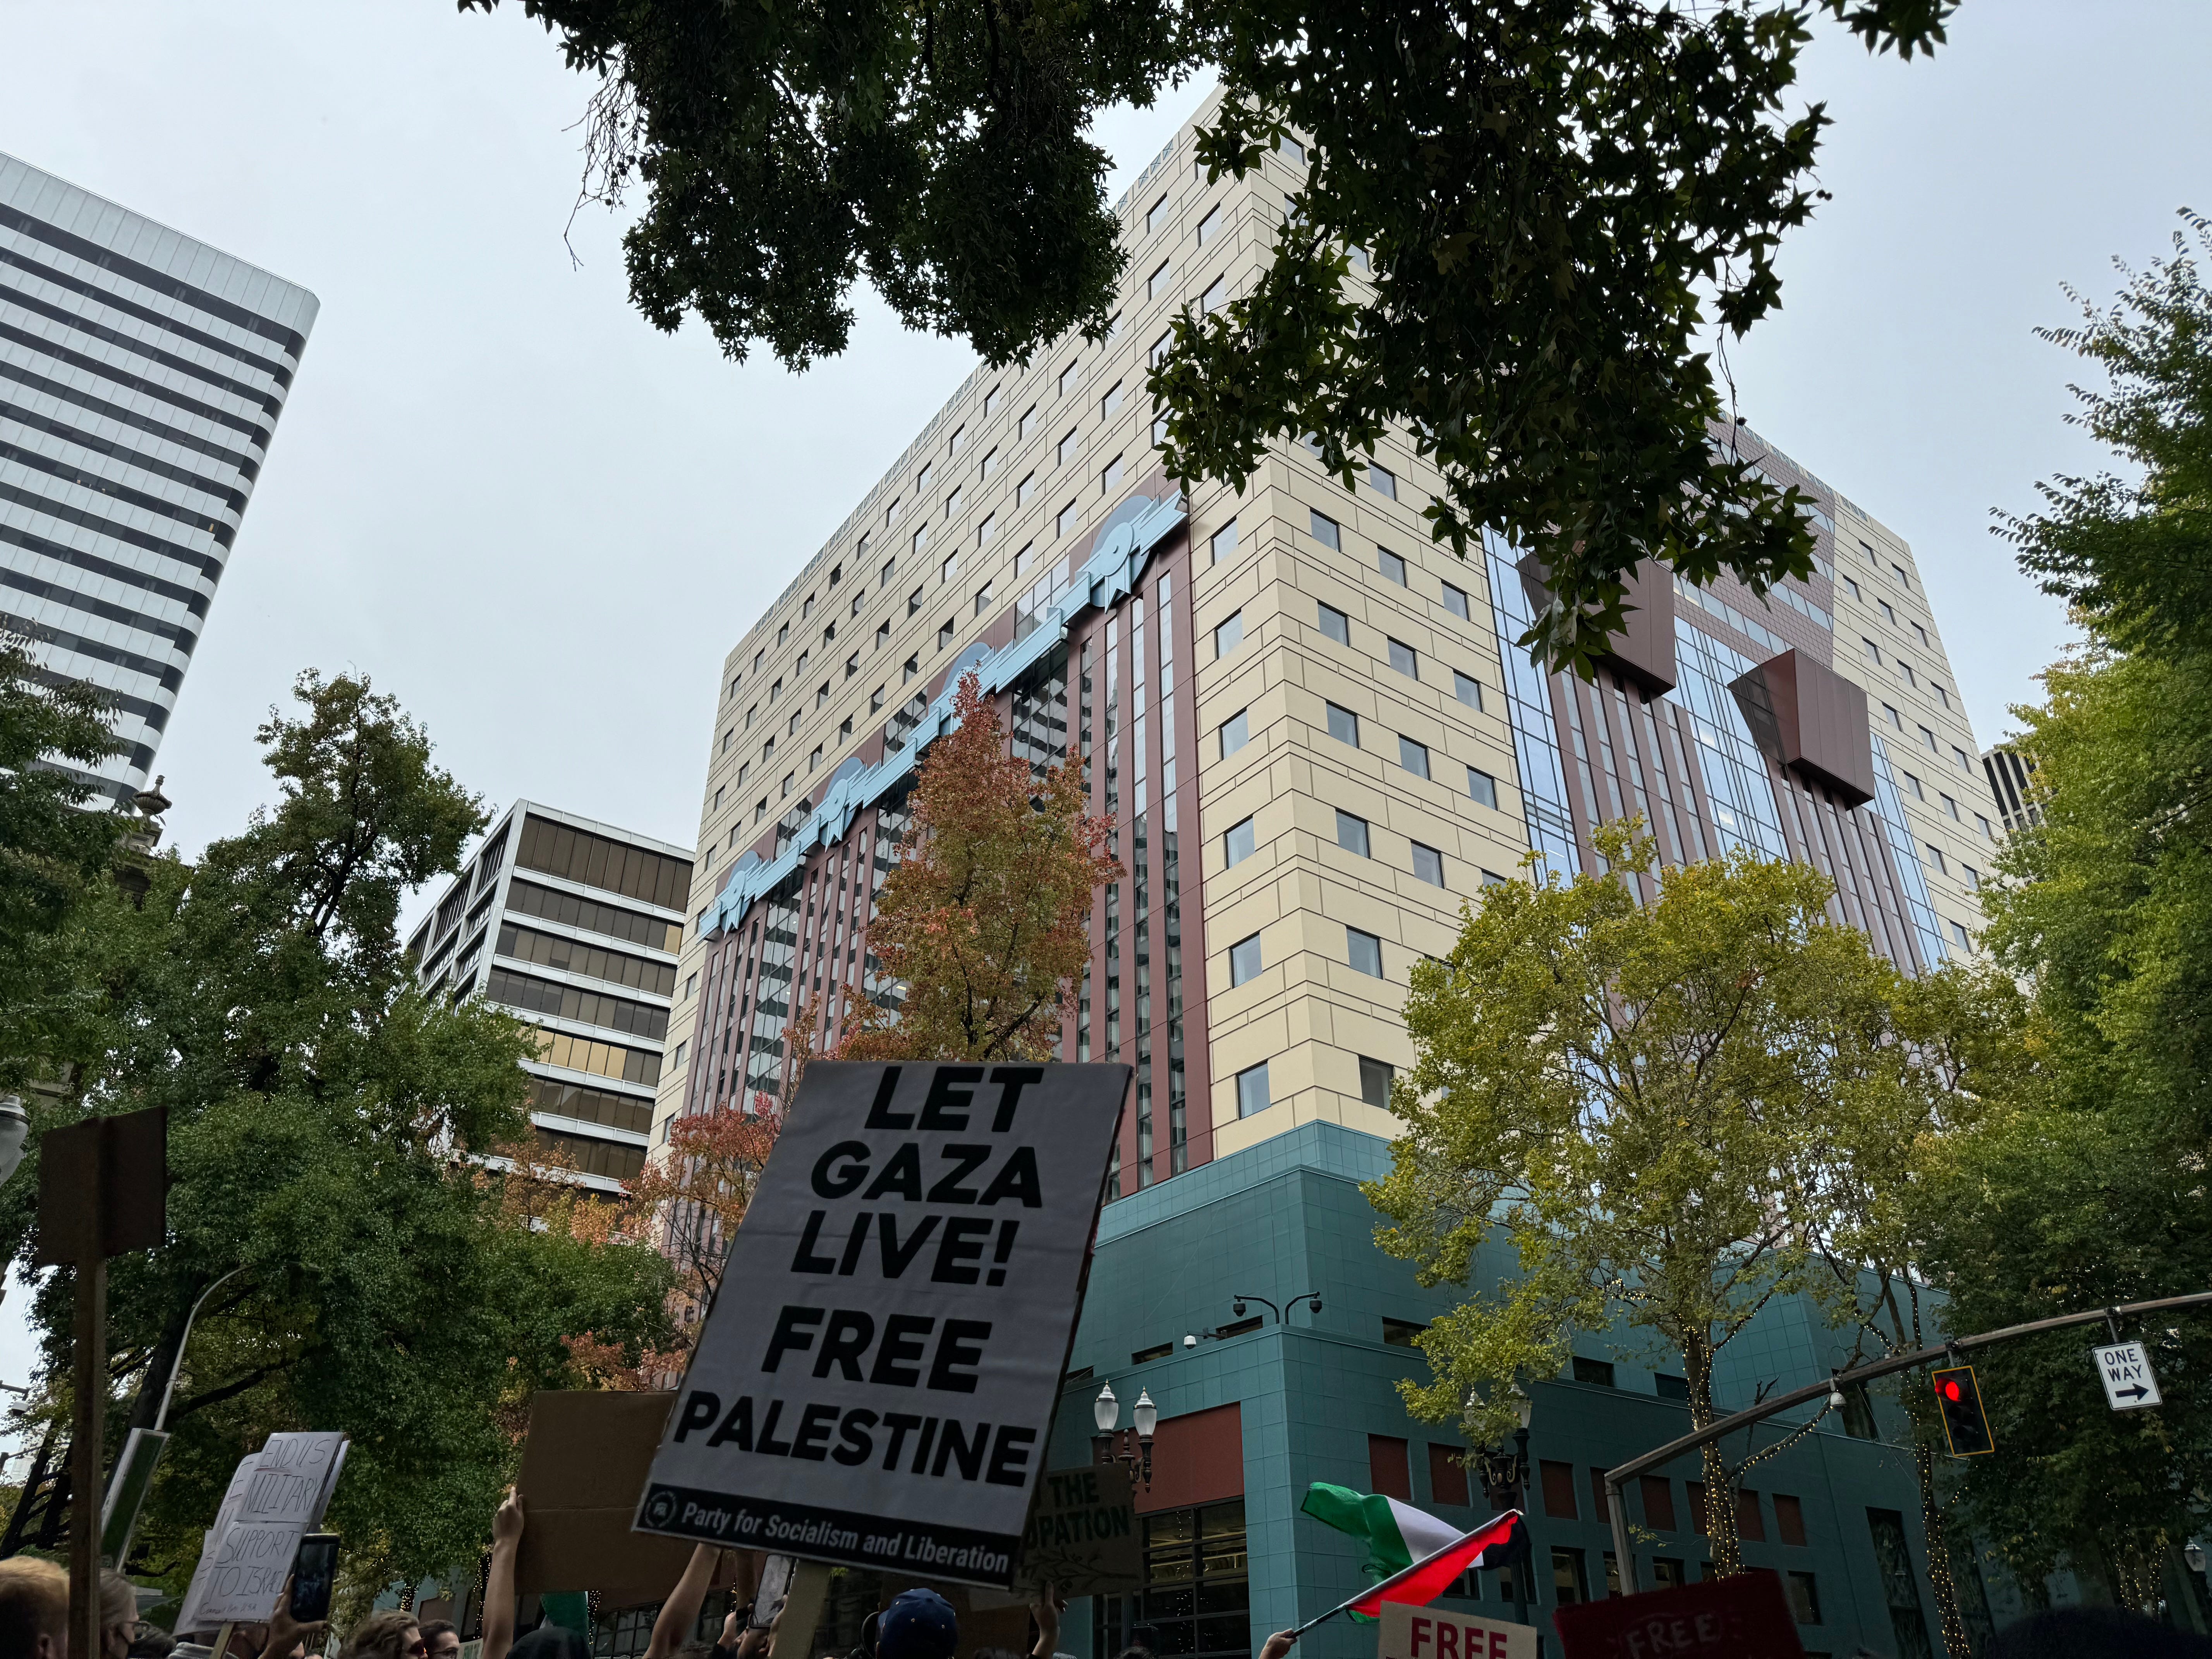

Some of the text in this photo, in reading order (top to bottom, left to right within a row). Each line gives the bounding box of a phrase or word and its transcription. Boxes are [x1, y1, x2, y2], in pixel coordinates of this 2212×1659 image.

[864, 1066, 1044, 1132] LET
[811, 1140, 1042, 1208] GAZA
[790, 1210, 1020, 1286] LIVE!
[761, 1305, 993, 1394] FREE
[2104, 1348, 2138, 1365] ONE
[2107, 1364, 2141, 1382] WAY
[260, 1439, 331, 1468] END US
[673, 1390, 1036, 1487] PALESTINE
[242, 1474, 325, 1514] MILITARY
[1048, 1472, 1099, 1507] THE
[217, 1528, 300, 1564] SUPPORT
[682, 1502, 732, 1534] Party
[734, 1509, 763, 1533] for
[765, 1514, 858, 1548] Socialism
[863, 1533, 902, 1556] and
[904, 1535, 1008, 1572] Liberation
[209, 1567, 241, 1602] TO
[1411, 1617, 1508, 1659] FREE
[1626, 1614, 1721, 1659] FREE
